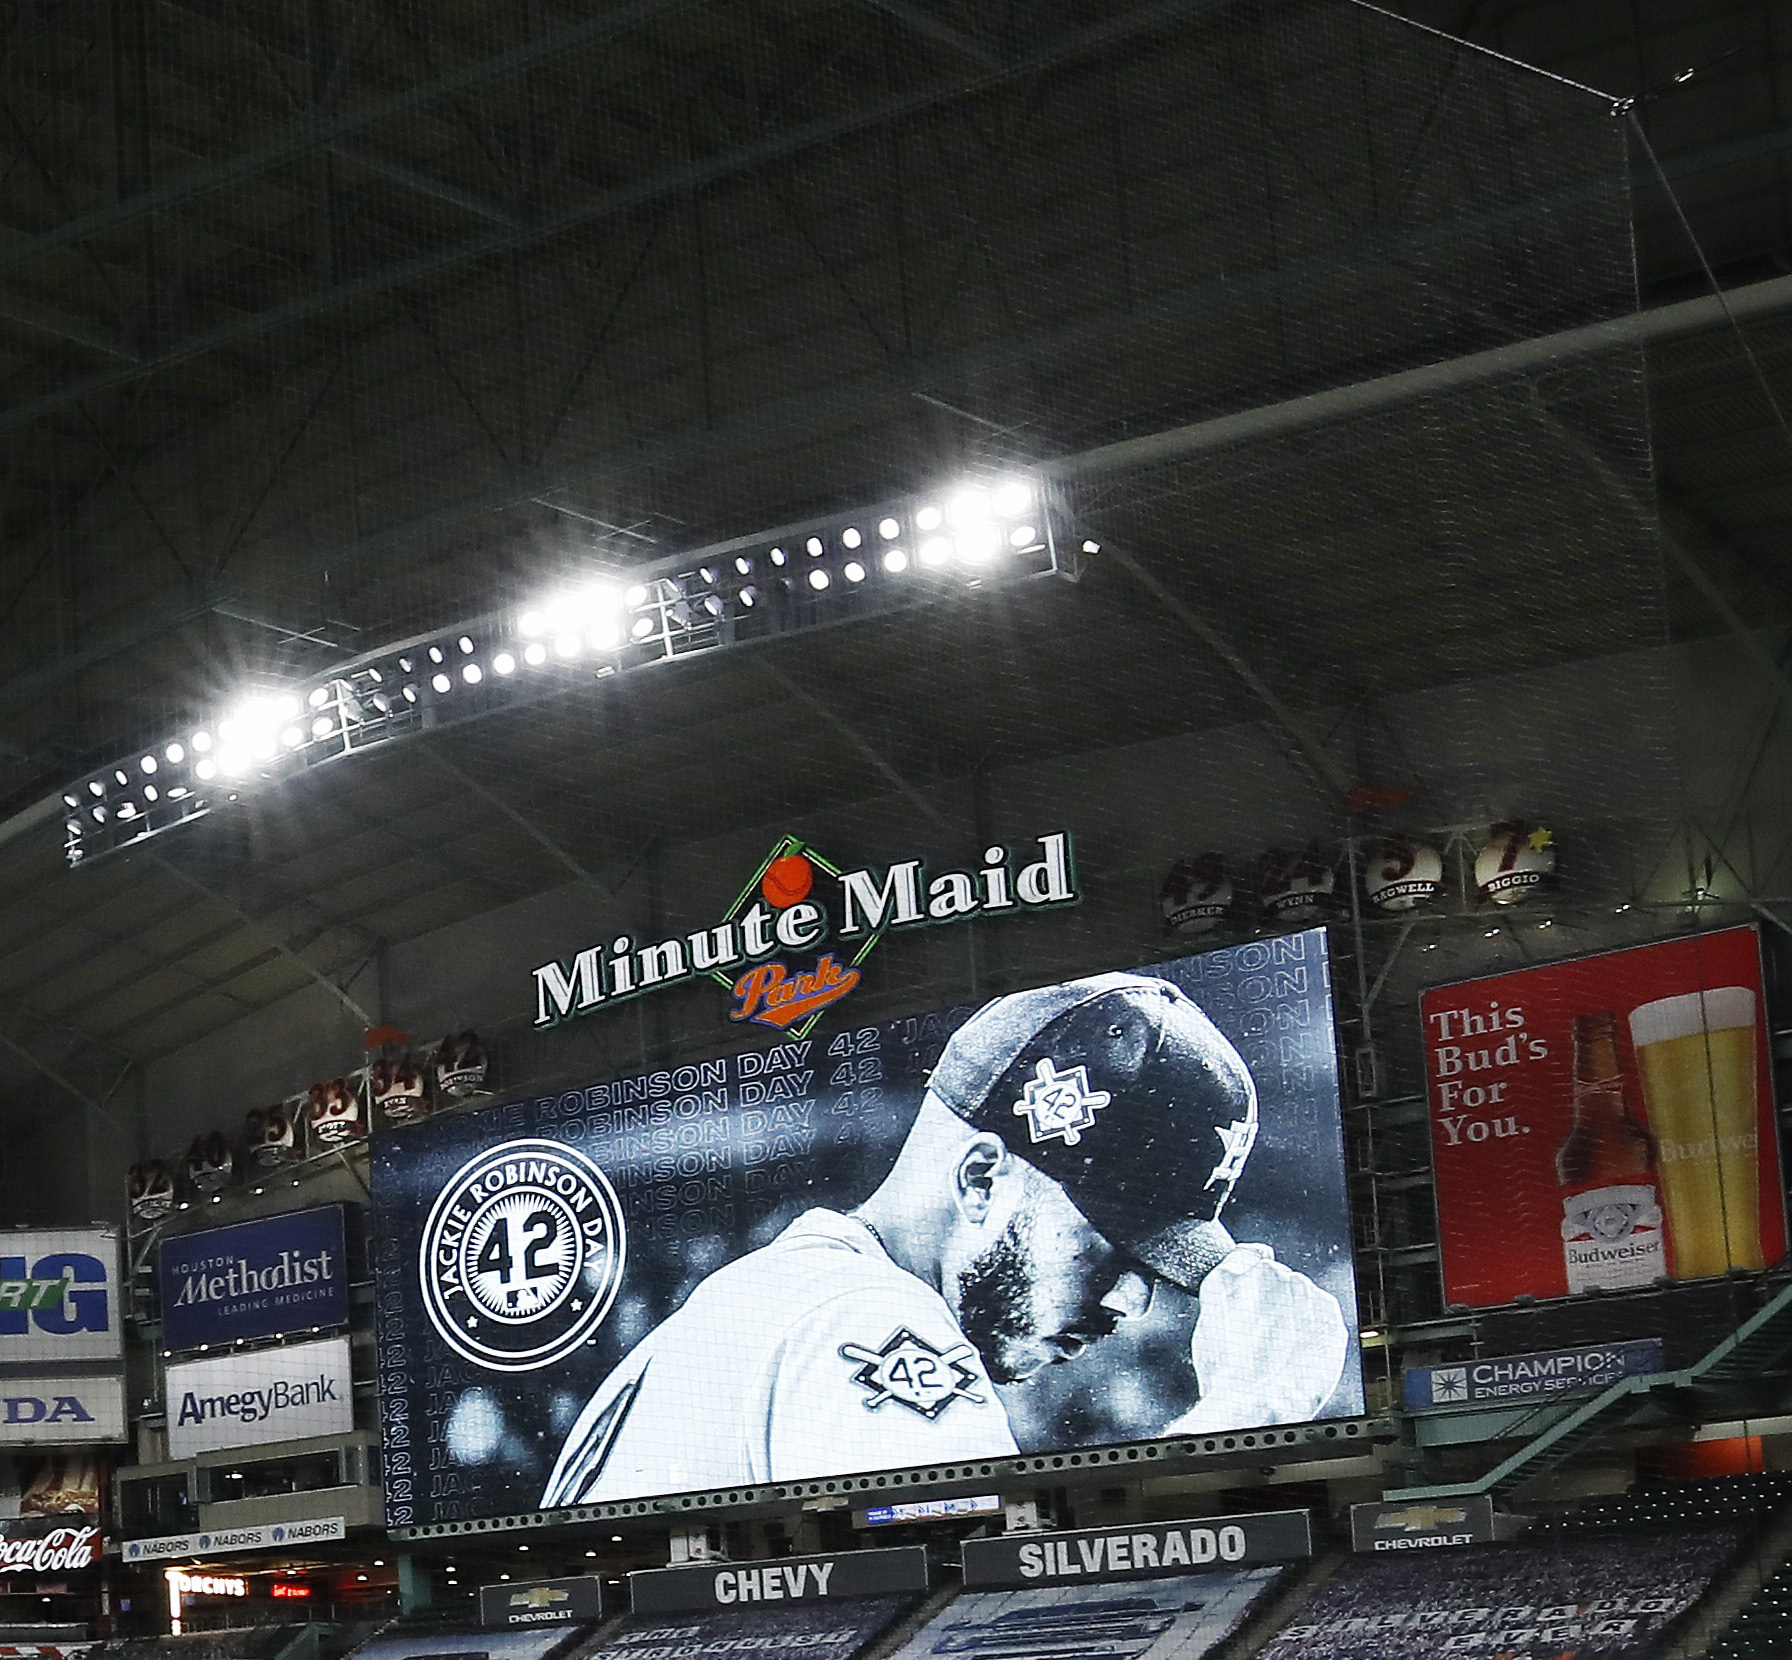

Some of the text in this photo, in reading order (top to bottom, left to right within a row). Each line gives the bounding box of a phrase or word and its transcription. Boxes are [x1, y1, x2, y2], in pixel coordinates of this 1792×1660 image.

[1488, 873, 1539, 892] BIGGIO
[533, 832, 1073, 1025] Minute Maid
[730, 953, 862, 1024] Park
[1429, 1001, 1525, 1041] This
[1434, 1032, 1548, 1077] Bud's
[1438, 1081, 1508, 1112] For
[1438, 1114, 1530, 1146] You.
[438, 1205, 472, 1300] JACKIE
[471, 1163, 593, 1212] ROBINSON
[586, 1217, 607, 1274] DAY
[478, 1210, 559, 1284] 42
[172, 1256, 234, 1276] HOUSTON
[1569, 1241, 1660, 1265] Budweiser
[174, 1250, 334, 1307] Methodist
[177, 1373, 336, 1428] AmegyBank
[143, 1540, 189, 1555] NABORS
[213, 1532, 262, 1548] NABORS
[287, 1521, 338, 1539] NABORS
[1374, 1533, 1474, 1551] CHEVROLET
[1018, 1525, 1246, 1579] SILVERADO
[715, 1562, 835, 1603] CHEVY
[509, 1609, 573, 1624] CHEVROLET
